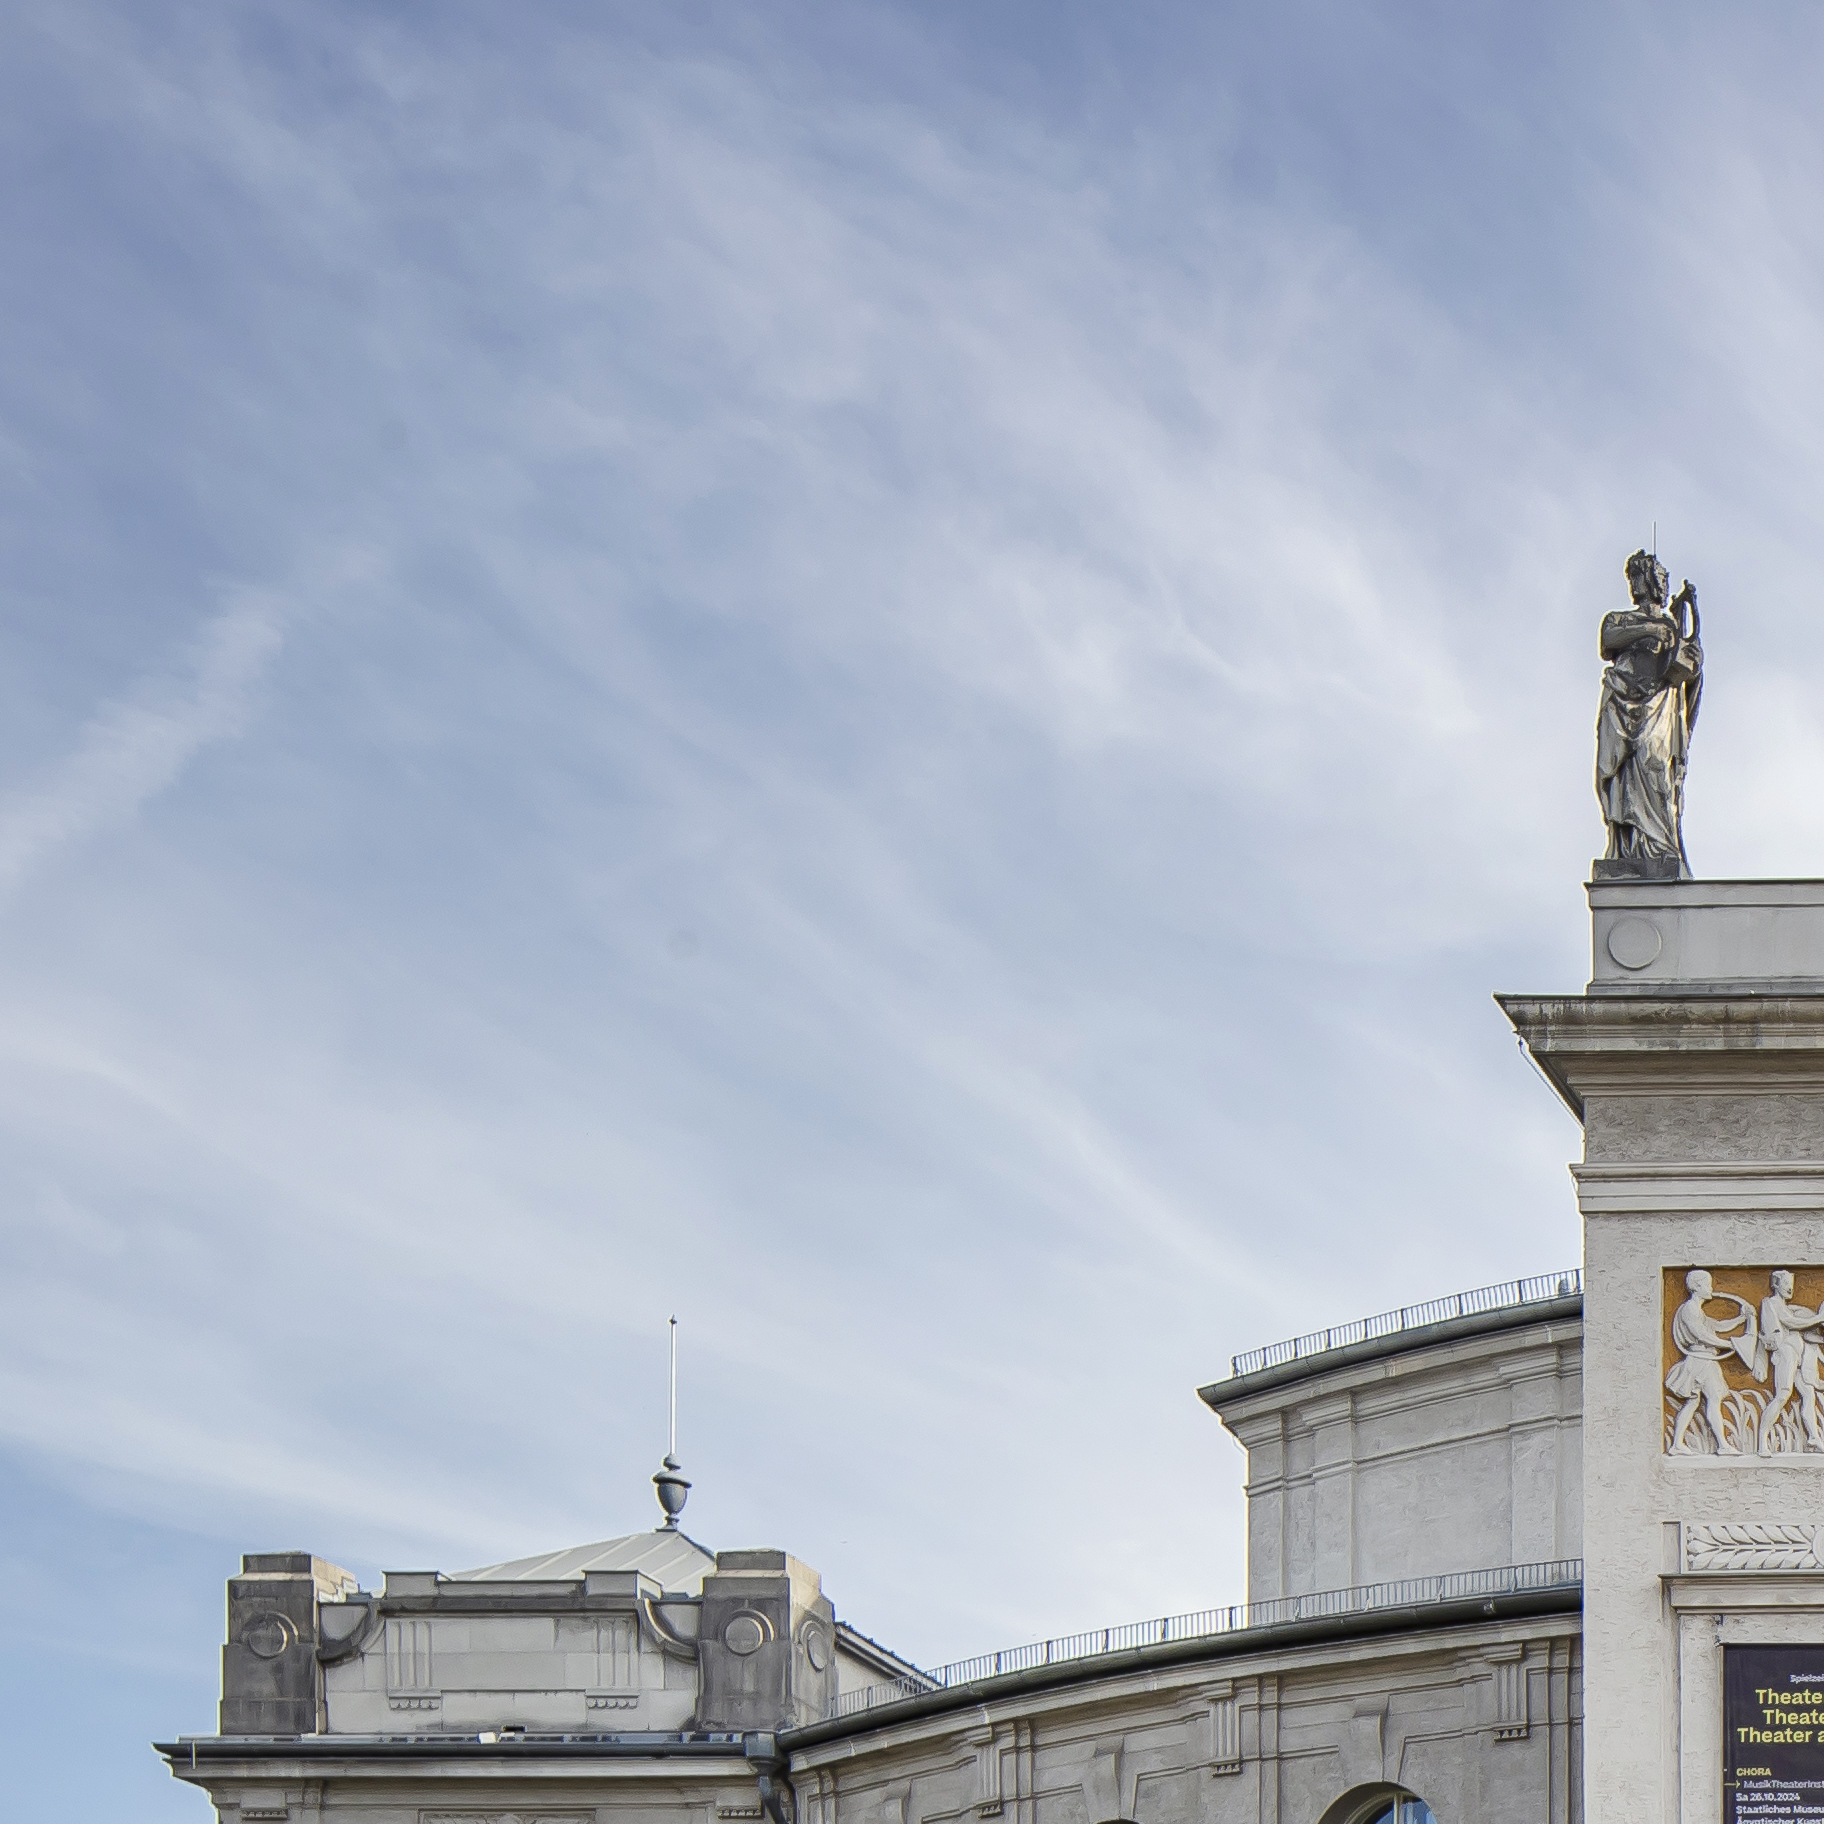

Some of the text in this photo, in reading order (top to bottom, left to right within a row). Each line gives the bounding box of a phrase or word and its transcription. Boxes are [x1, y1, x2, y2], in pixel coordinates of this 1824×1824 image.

[1737, 1727, 1813, 1743] Theater
[1736, 1767, 1772, 1776] CHORA
[1735, 1792, 1748, 1801] Sa
[1735, 1804, 1791, 1814] Staatliches
